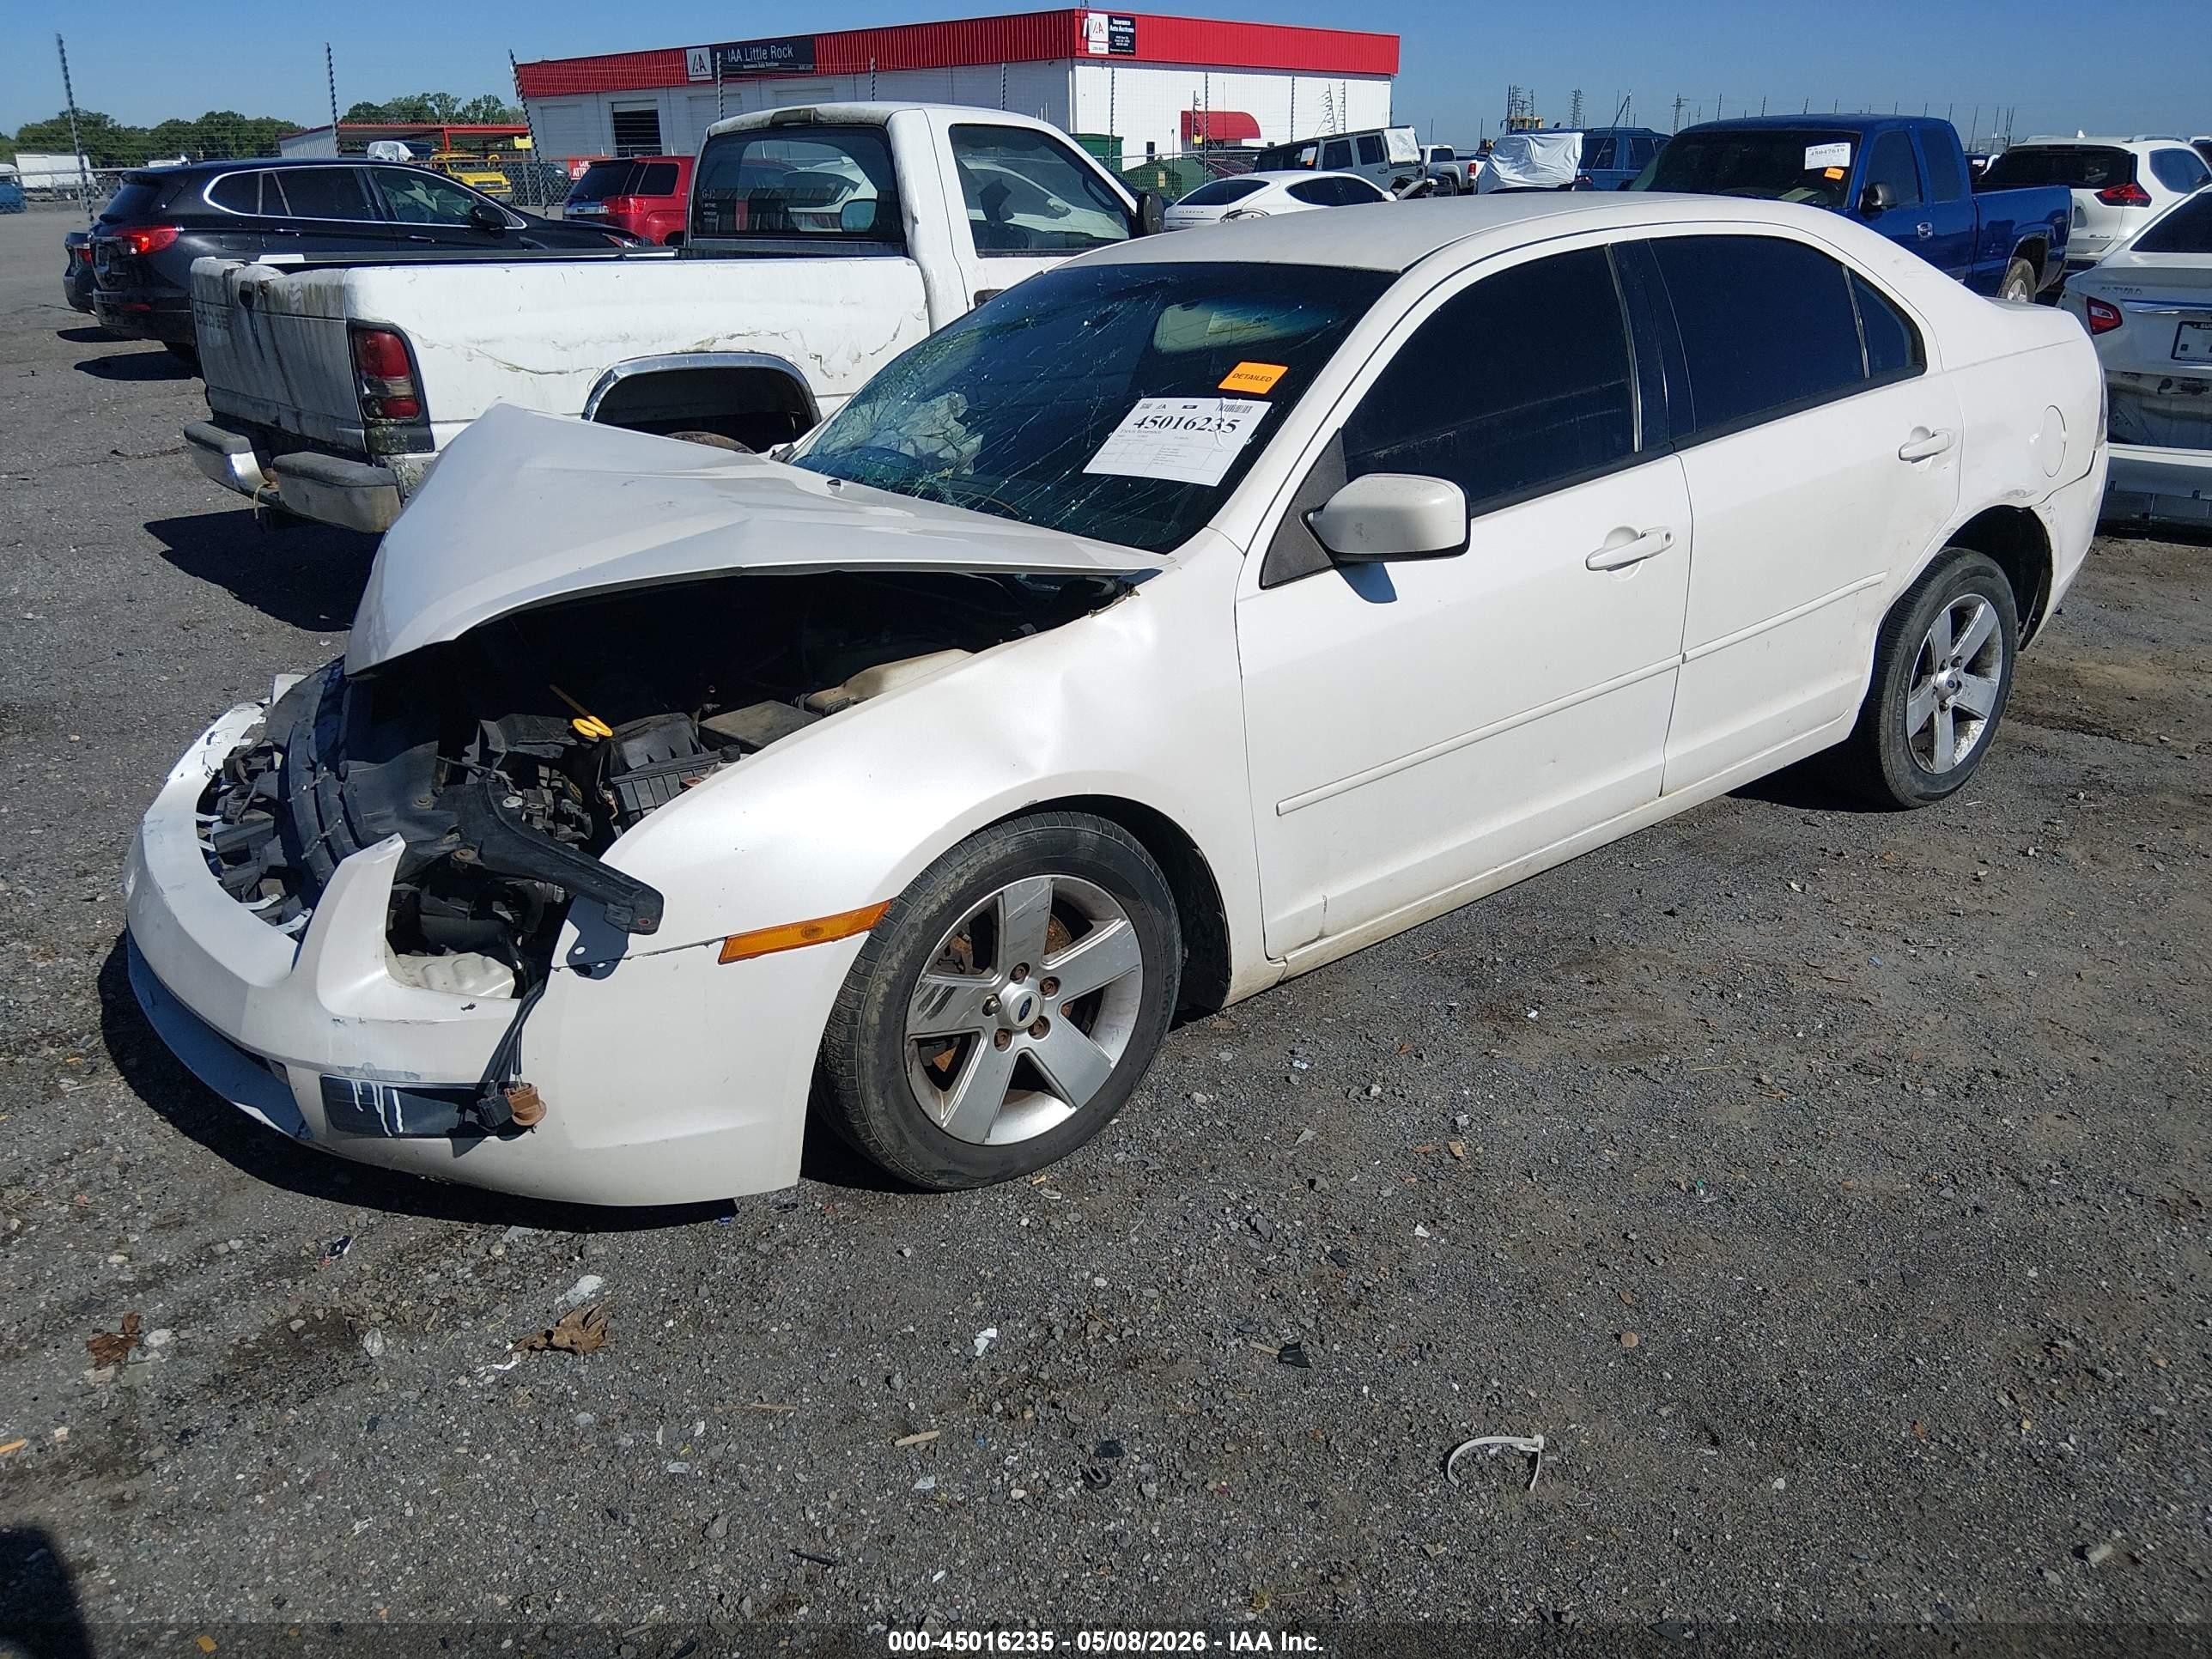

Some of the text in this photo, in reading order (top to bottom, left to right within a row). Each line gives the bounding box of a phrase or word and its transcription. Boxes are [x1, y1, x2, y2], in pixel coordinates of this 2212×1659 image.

[727, 44, 794, 63] IAA Little Rock
[1232, 373, 1273, 383] DETAILED
[1133, 415, 1242, 434] 45016235
